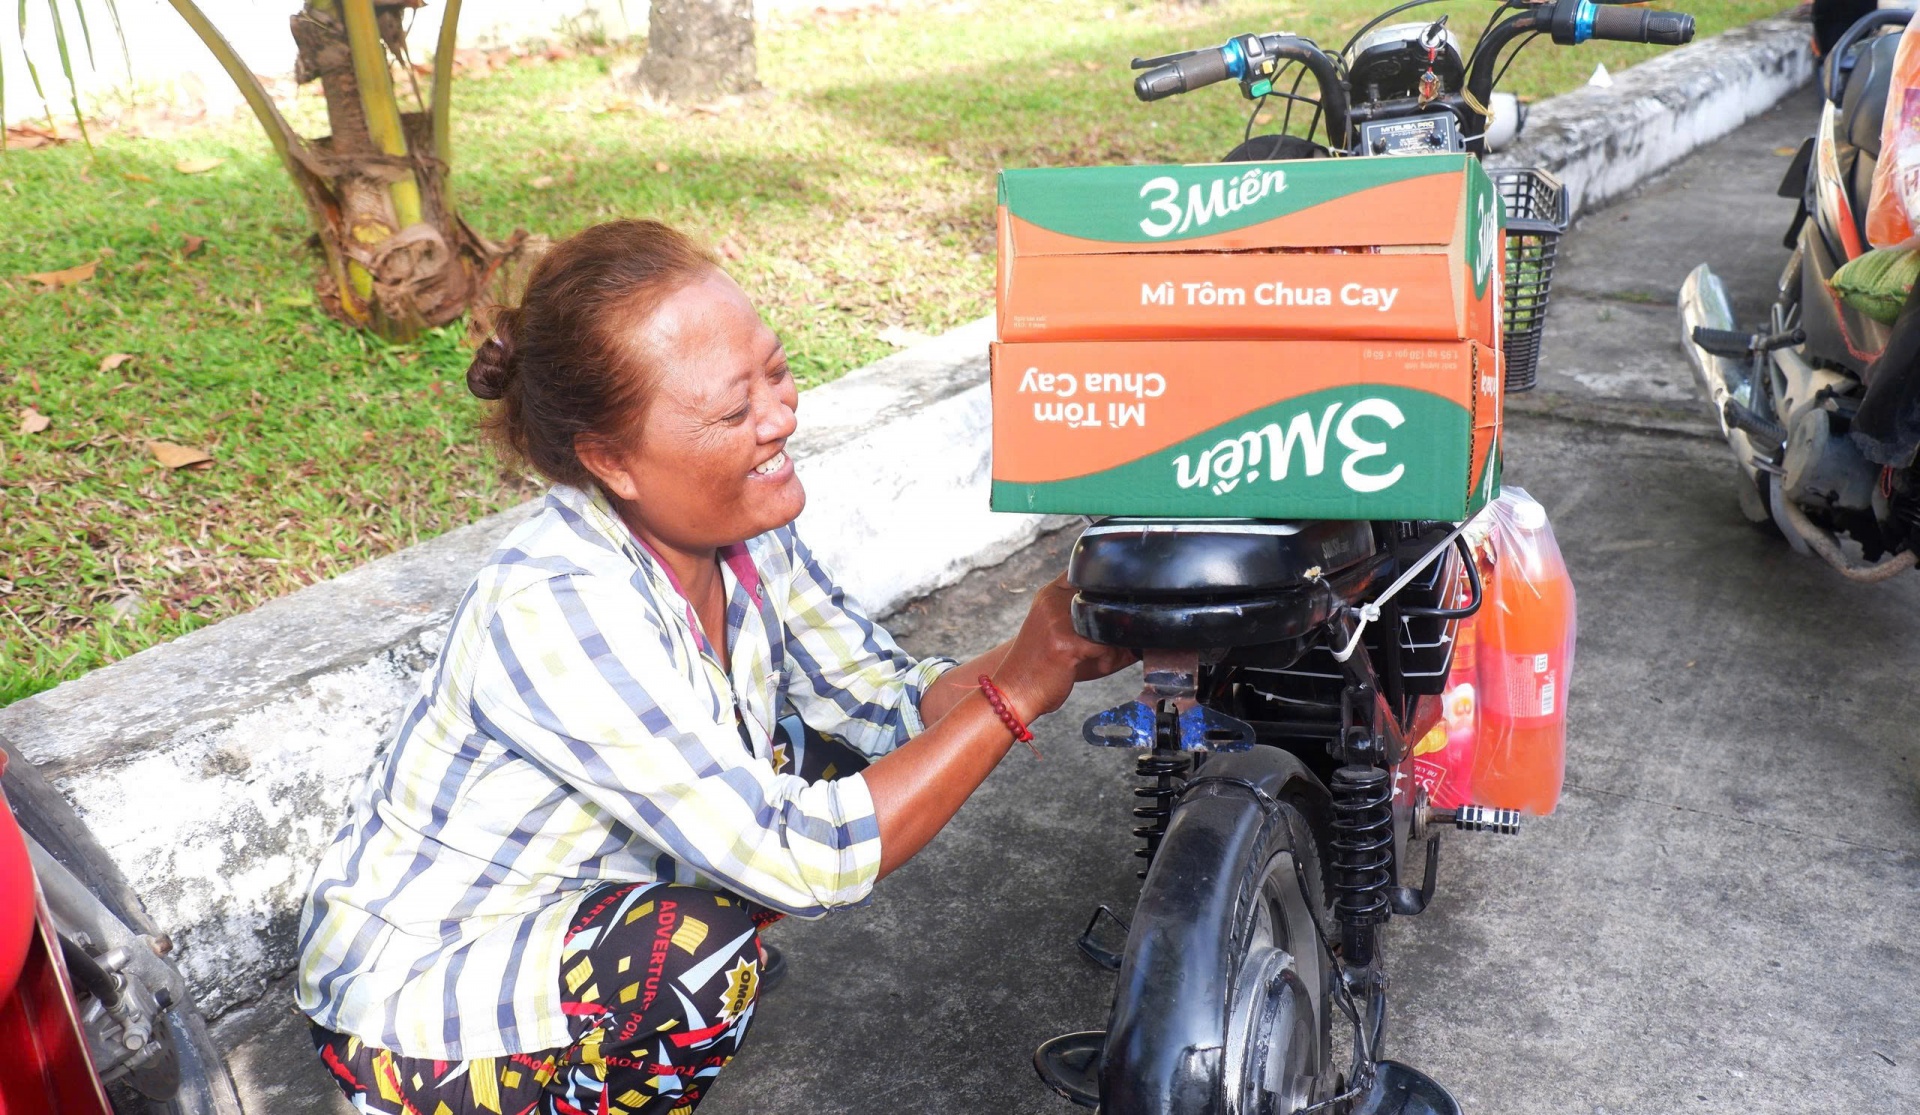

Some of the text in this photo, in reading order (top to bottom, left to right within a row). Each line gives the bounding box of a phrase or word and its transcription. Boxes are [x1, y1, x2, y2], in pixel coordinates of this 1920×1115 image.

[1139, 167, 1288, 238] 3 Miền
[1140, 280, 1399, 312] Mì Tôm Chua Cay
[1018, 367, 1167, 398] Chua Cay
[1033, 402, 1145, 429] Mì Tôm
[1173, 402, 1343, 496] Miền
[1336, 398, 1406, 493] 3
